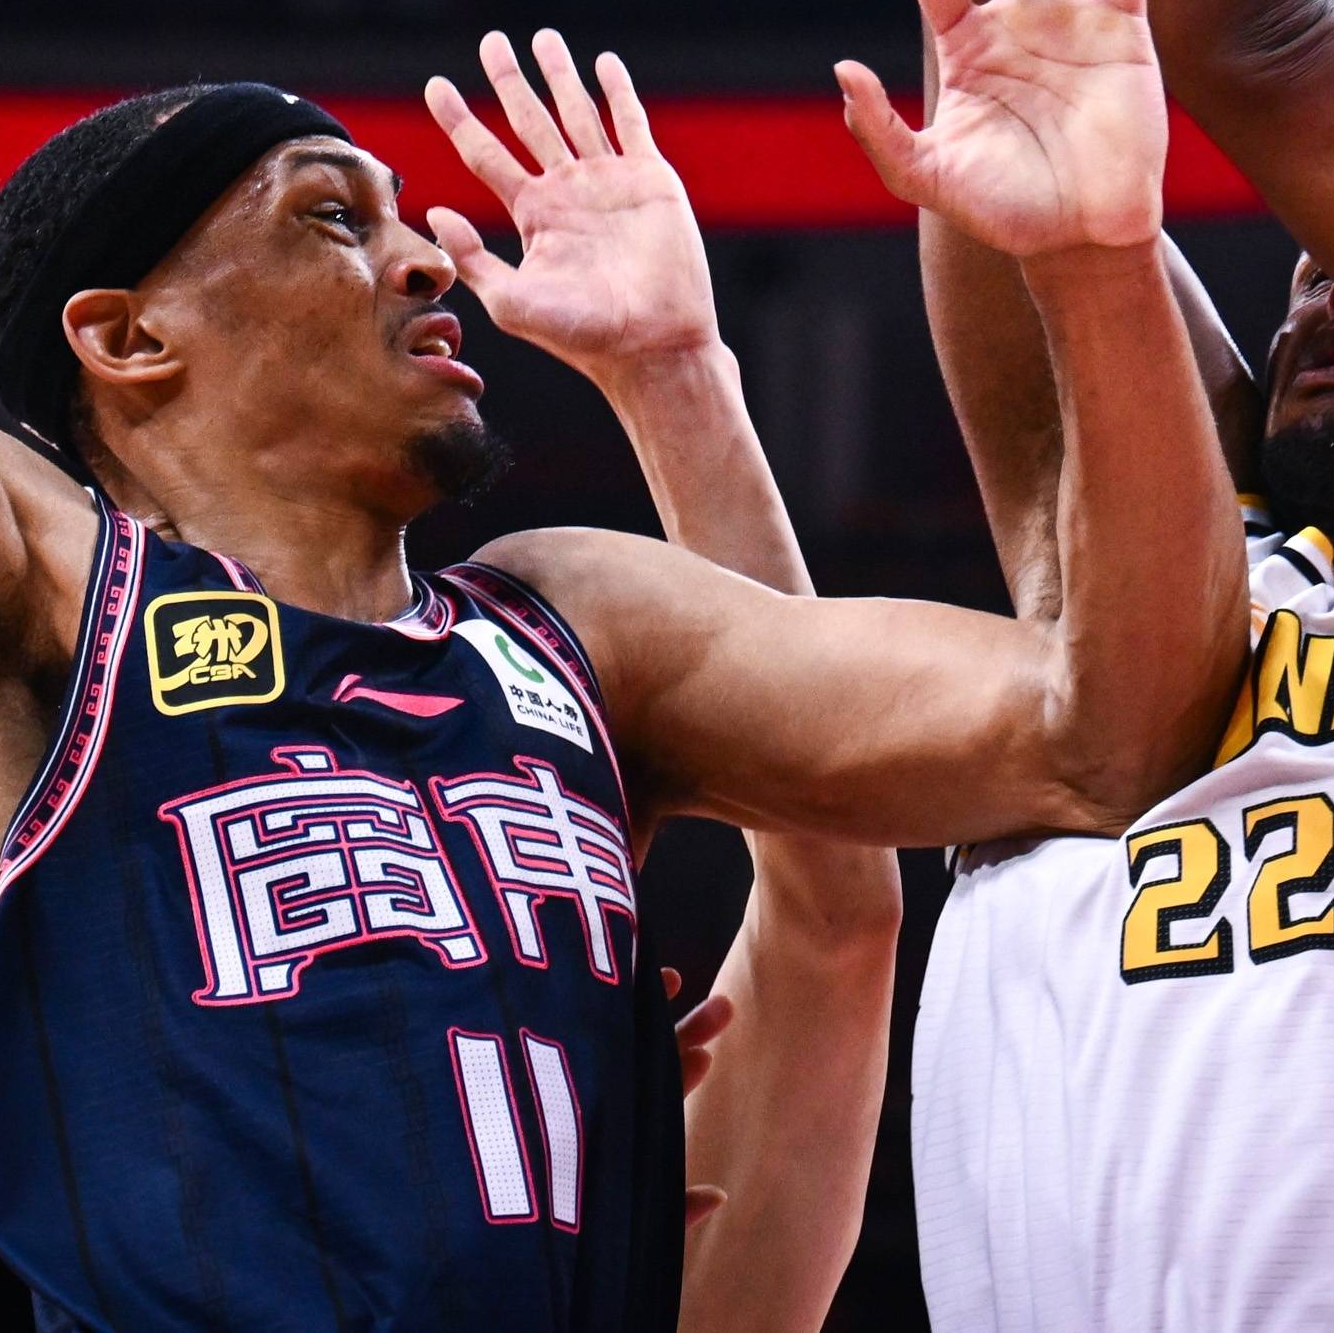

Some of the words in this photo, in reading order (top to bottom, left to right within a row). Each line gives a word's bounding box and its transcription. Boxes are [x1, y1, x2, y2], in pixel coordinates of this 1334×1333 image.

[189, 661, 257, 685] CBA
[508, 683, 578, 722] 中国人寿
[516, 704, 556, 723] CHINA
[558, 718, 584, 737] LIFE
[446, 1027, 585, 1234] 11
